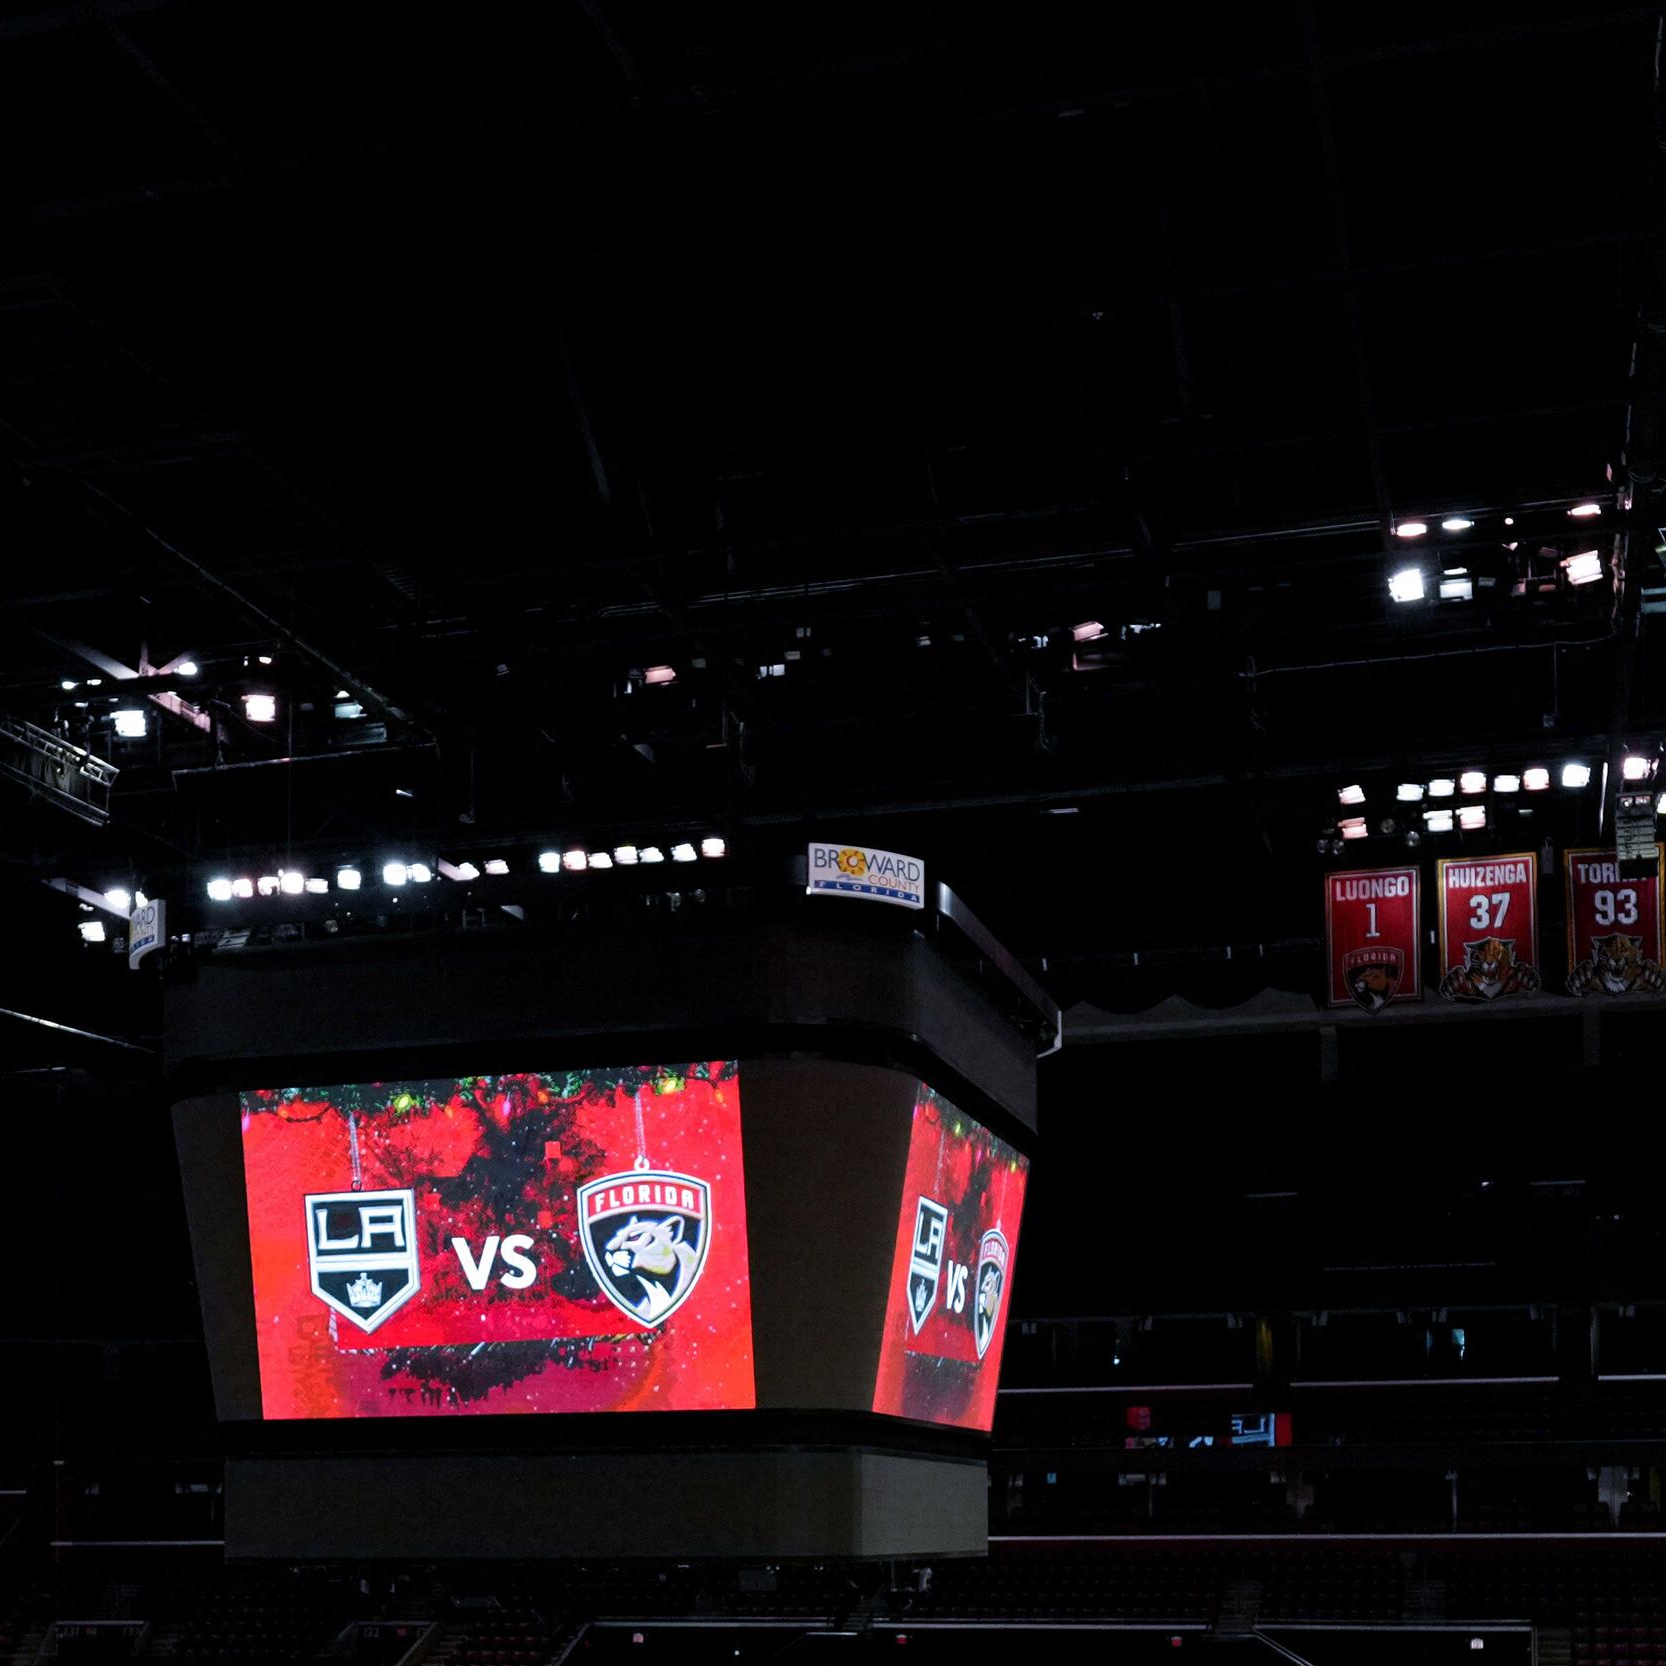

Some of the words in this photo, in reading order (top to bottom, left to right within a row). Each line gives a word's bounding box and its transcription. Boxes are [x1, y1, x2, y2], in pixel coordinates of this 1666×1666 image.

[814, 848, 920, 882] BROWARD
[1448, 863, 1527, 888] HUIZENGA
[819, 882, 918, 902] FLORIDA
[868, 874, 919, 893] COUNTY
[1336, 876, 1410, 901] LUONGO
[1365, 903, 1380, 938] 1
[1469, 892, 1511, 930] 37
[1594, 889, 1639, 925] 93
[595, 1186, 695, 1212] FLORIDA
[314, 1205, 406, 1251] LA
[916, 1211, 943, 1259] LA
[452, 1233, 537, 1290] VS
[946, 1260, 968, 1313] VS
